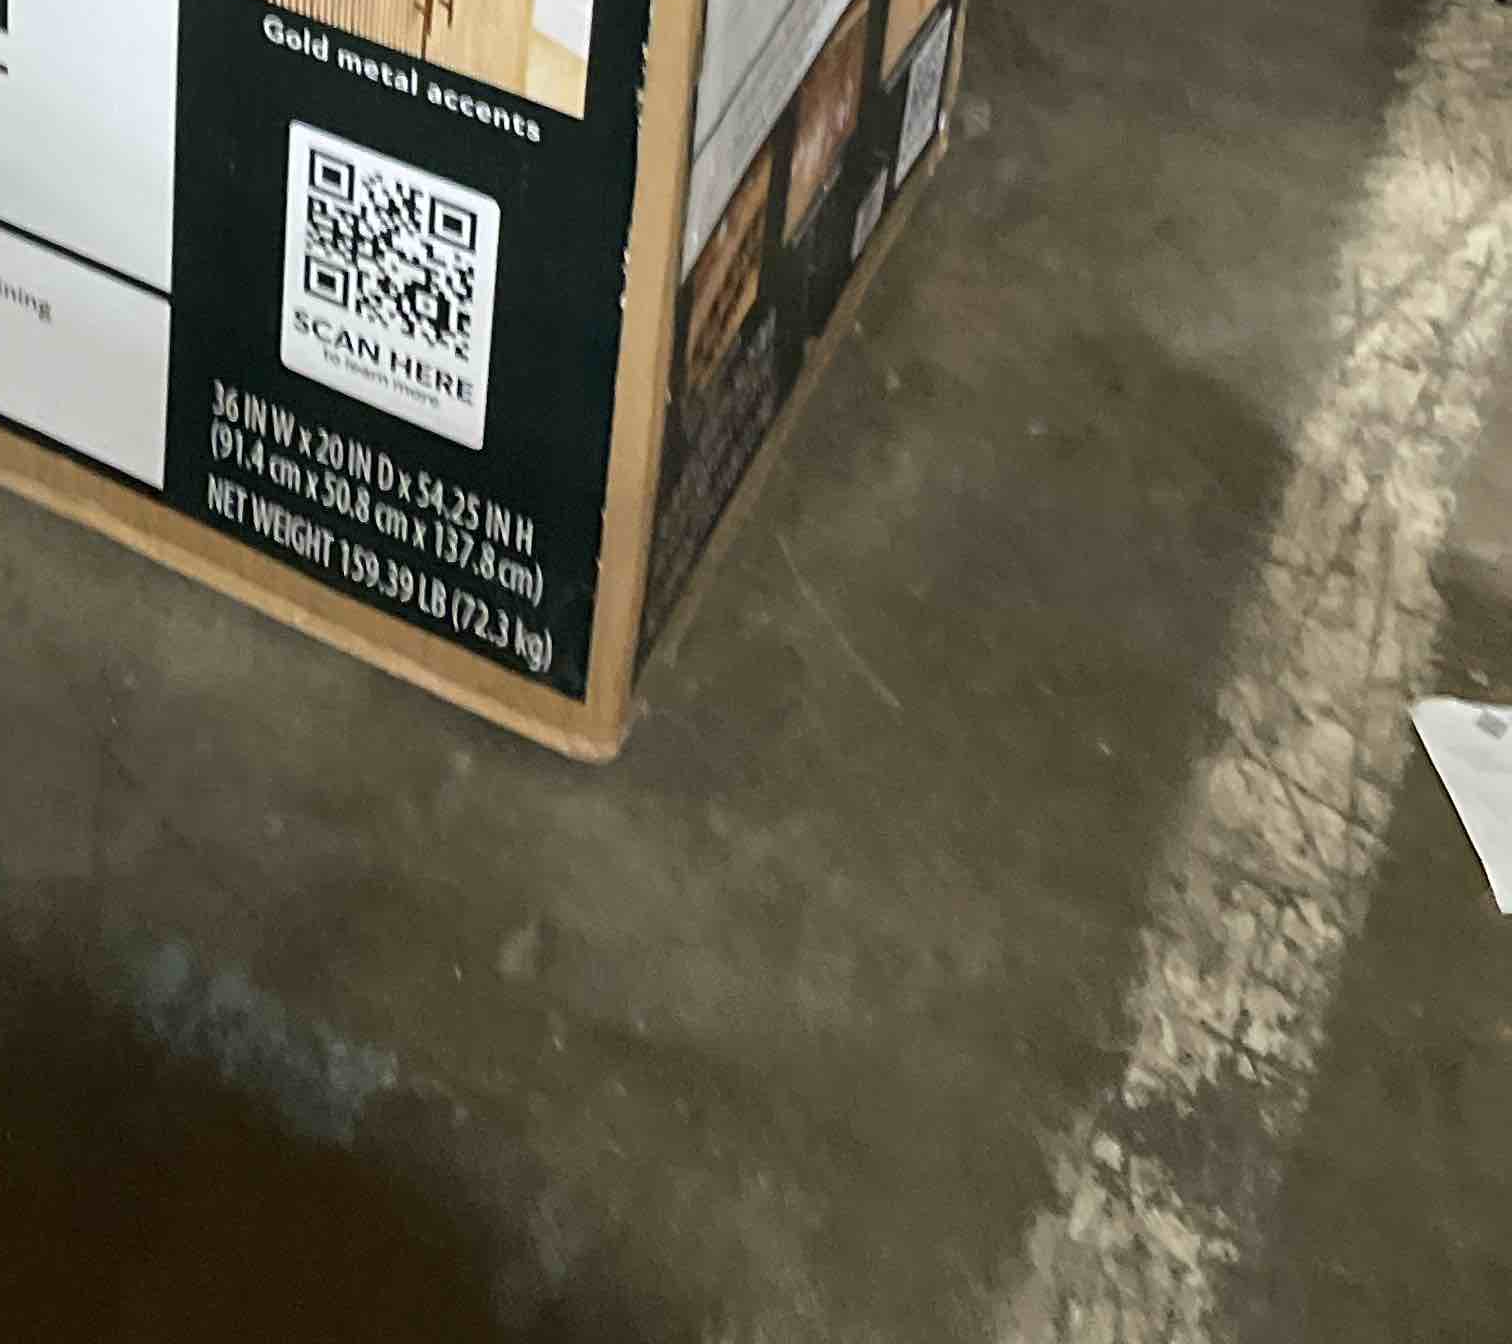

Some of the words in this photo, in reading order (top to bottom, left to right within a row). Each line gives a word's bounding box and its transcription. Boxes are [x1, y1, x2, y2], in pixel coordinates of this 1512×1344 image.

[262, 13, 329, 62] Gold
[337, 47, 418, 97] metal
[427, 81, 541, 144] accents
[293, 307, 380, 362] SCAN
[390, 348, 475, 406] HERE
[211, 378, 240, 422] 36
[244, 393, 267, 437] IN
[271, 404, 295, 448] W
[316, 428, 345, 470] 20
[348, 437, 373, 484] IN
[377, 451, 394, 492] D
[416, 470, 481, 531] 54.25
[485, 499, 511, 548] IN
[515, 513, 534, 557] H
[269, 452, 301, 490] cm
[321, 472, 371, 523] 50.8
[375, 501, 408, 544] cm
[207, 472, 248, 523] NET
[251, 490, 336, 568] WEIGHT
[418, 571, 448, 620] LB
